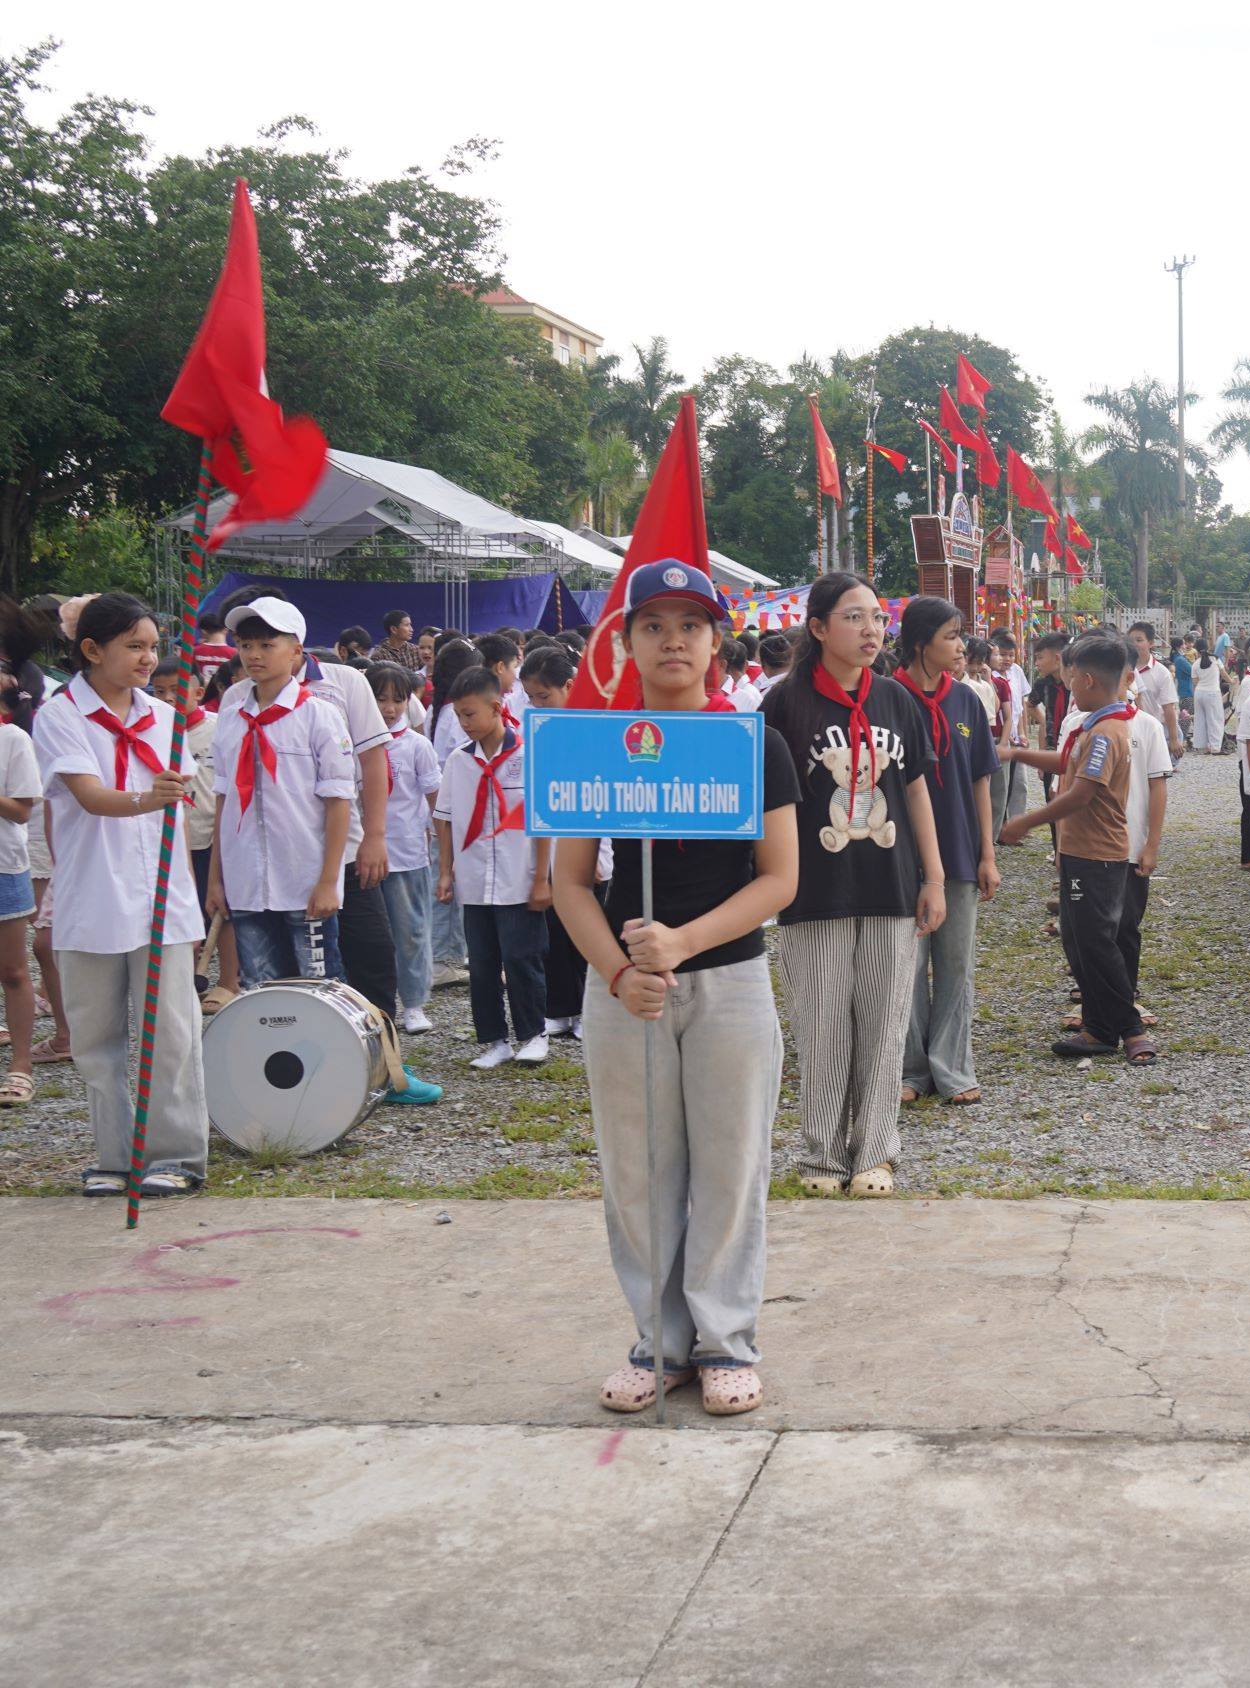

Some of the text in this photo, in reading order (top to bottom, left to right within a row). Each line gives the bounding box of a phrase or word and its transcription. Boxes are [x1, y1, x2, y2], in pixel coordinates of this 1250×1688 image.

[548, 775, 740, 820] CHI ĐỘI THÔN TÂN BÌNH
[268, 1015, 298, 1025] YAMAHA
